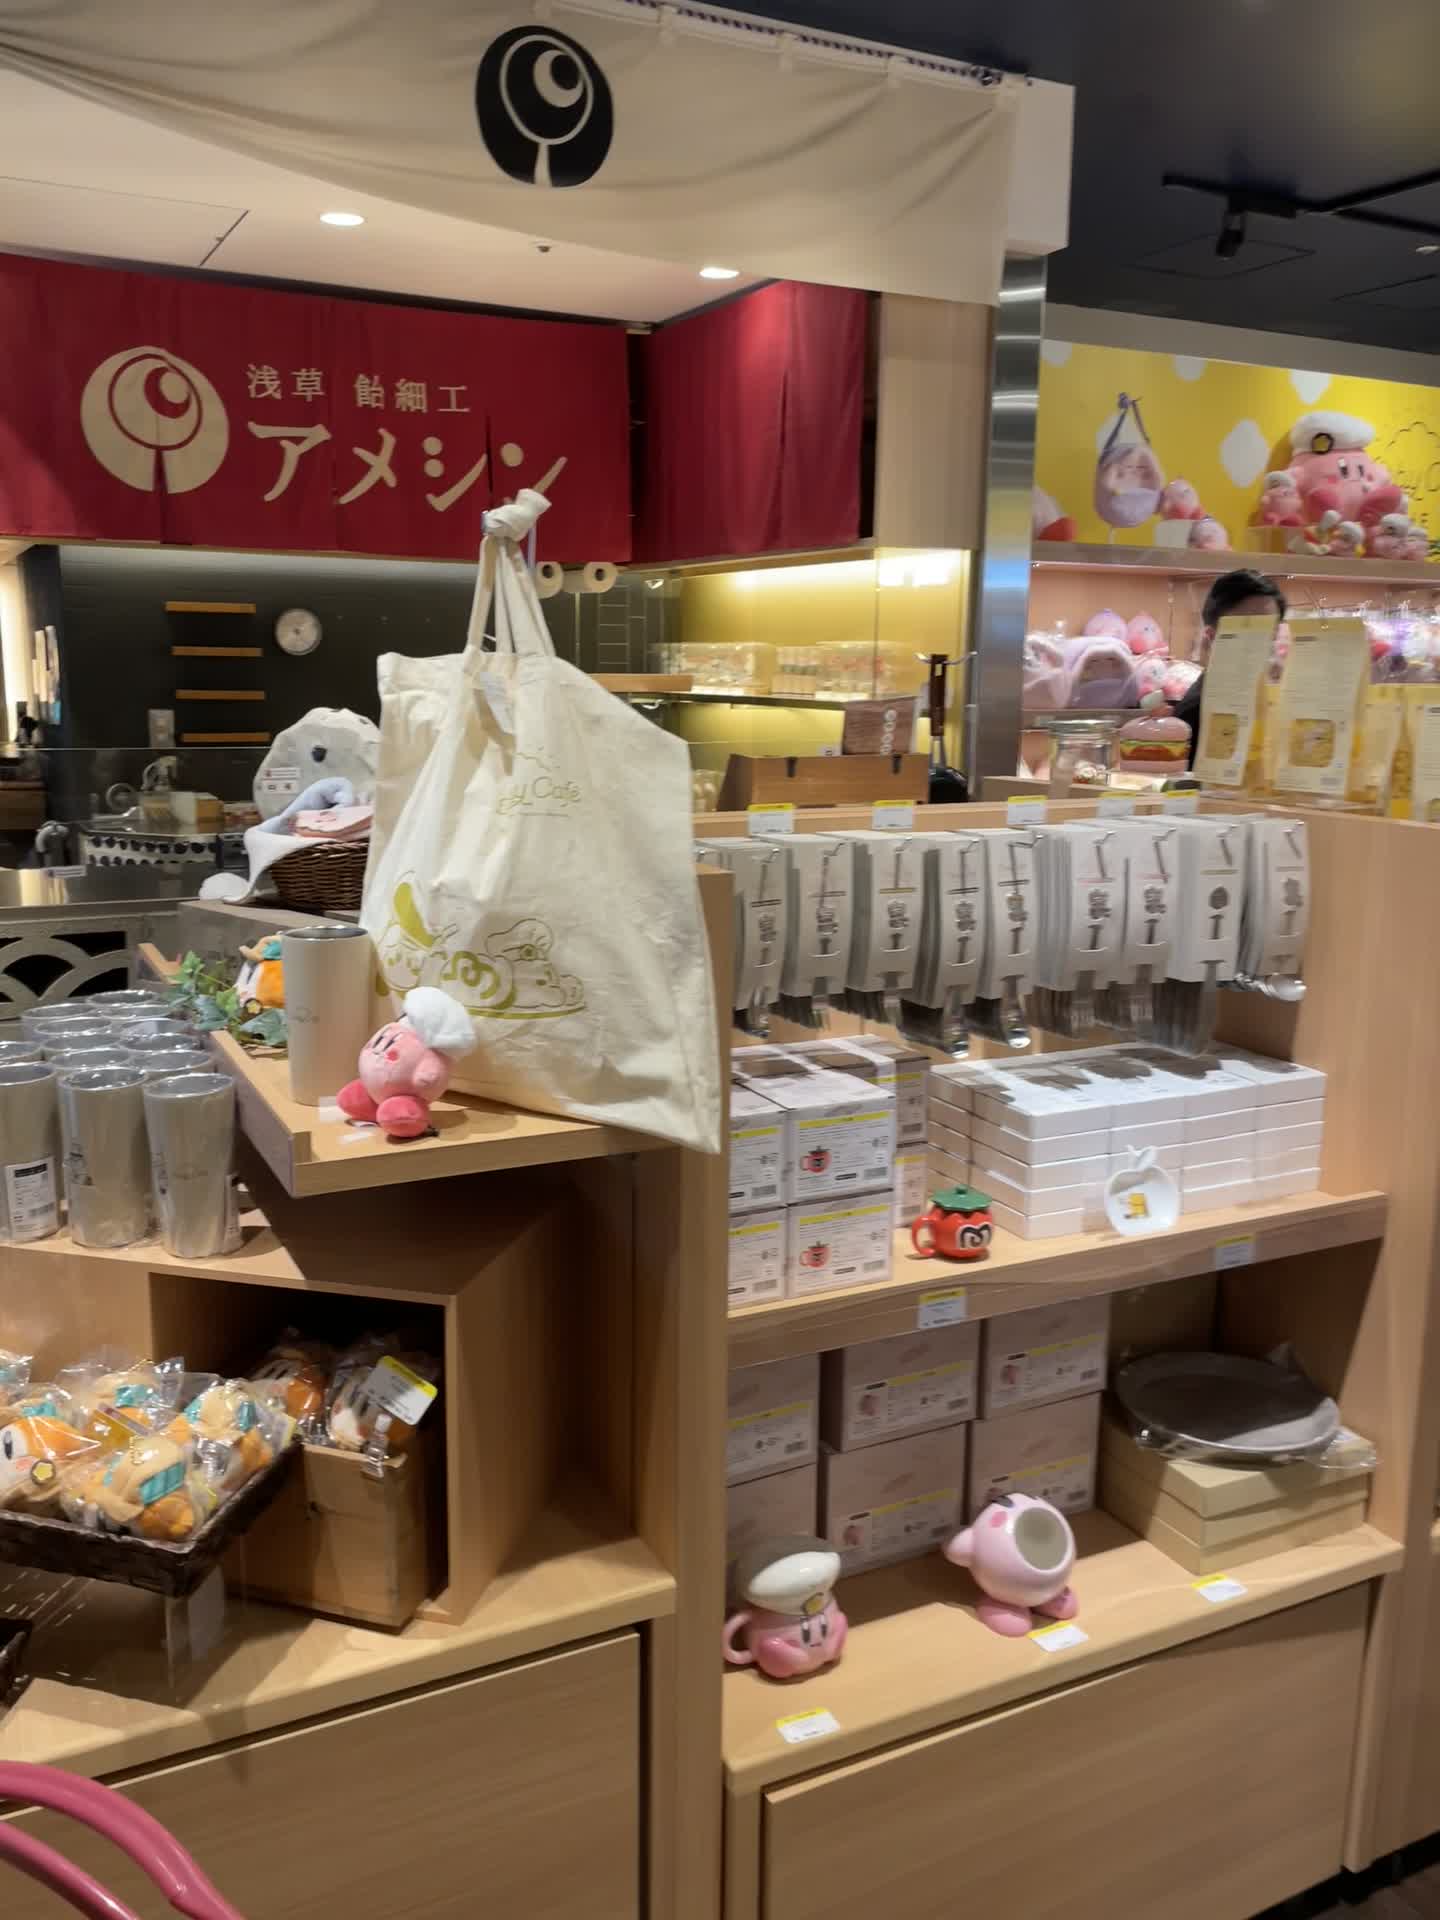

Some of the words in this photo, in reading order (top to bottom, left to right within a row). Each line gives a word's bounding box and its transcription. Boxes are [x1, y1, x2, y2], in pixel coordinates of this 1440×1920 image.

[247, 364, 326, 401] 浅草
[354, 374, 471, 413] 飴細工
[247, 421, 568, 512] アメシン
